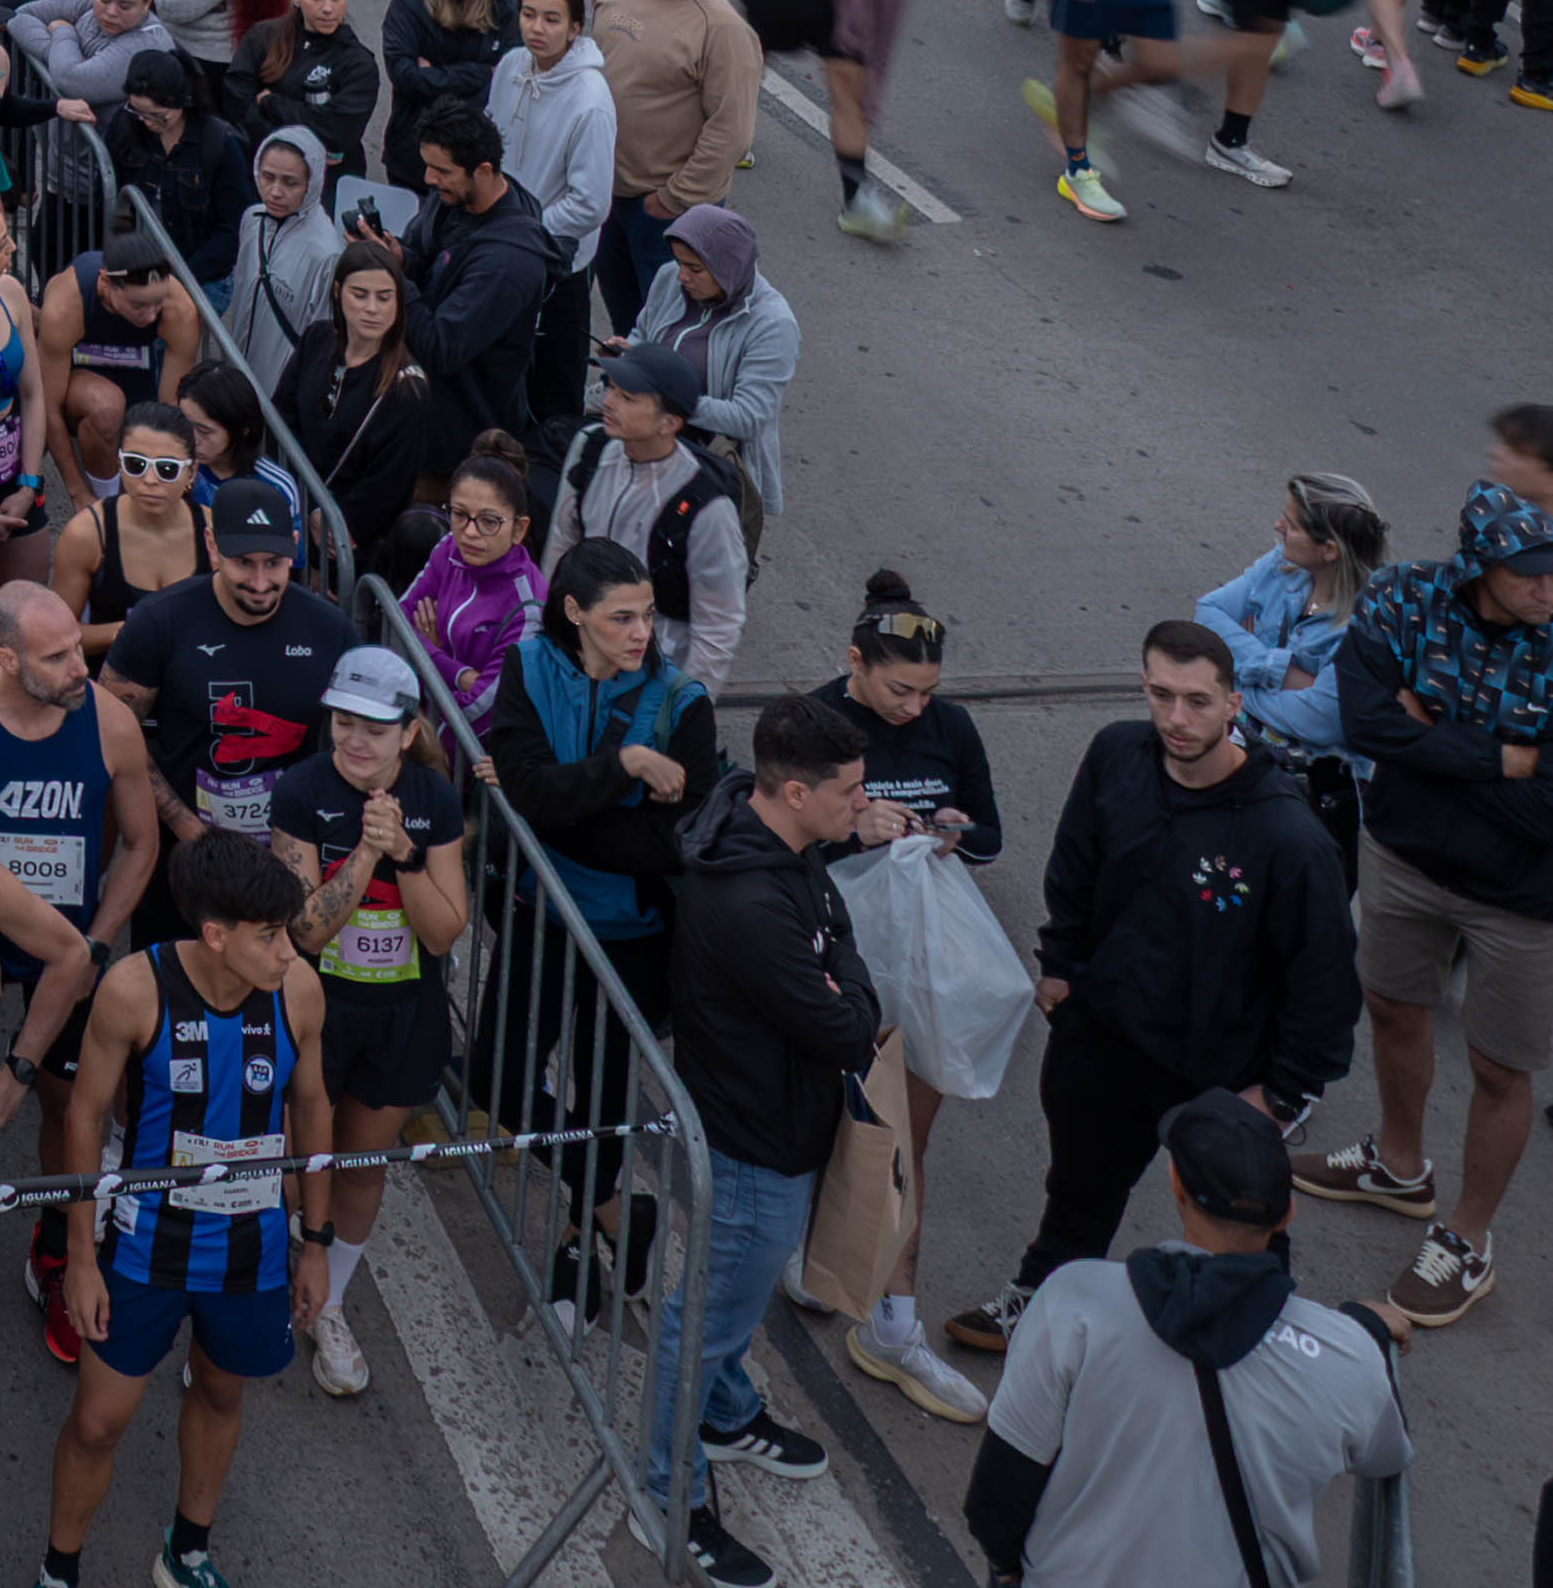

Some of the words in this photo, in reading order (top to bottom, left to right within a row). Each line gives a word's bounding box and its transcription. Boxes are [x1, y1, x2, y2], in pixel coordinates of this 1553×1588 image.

[14, 837, 35, 847] RUN
[8, 859, 68, 879] 8008
[356, 934, 404, 954] 6137
[176, 1021, 208, 1042] 3M
[241, 1025, 264, 1036] vivo
[213, 1141, 235, 1151] RUN
[226, 1145, 259, 1158] BRIDGE
